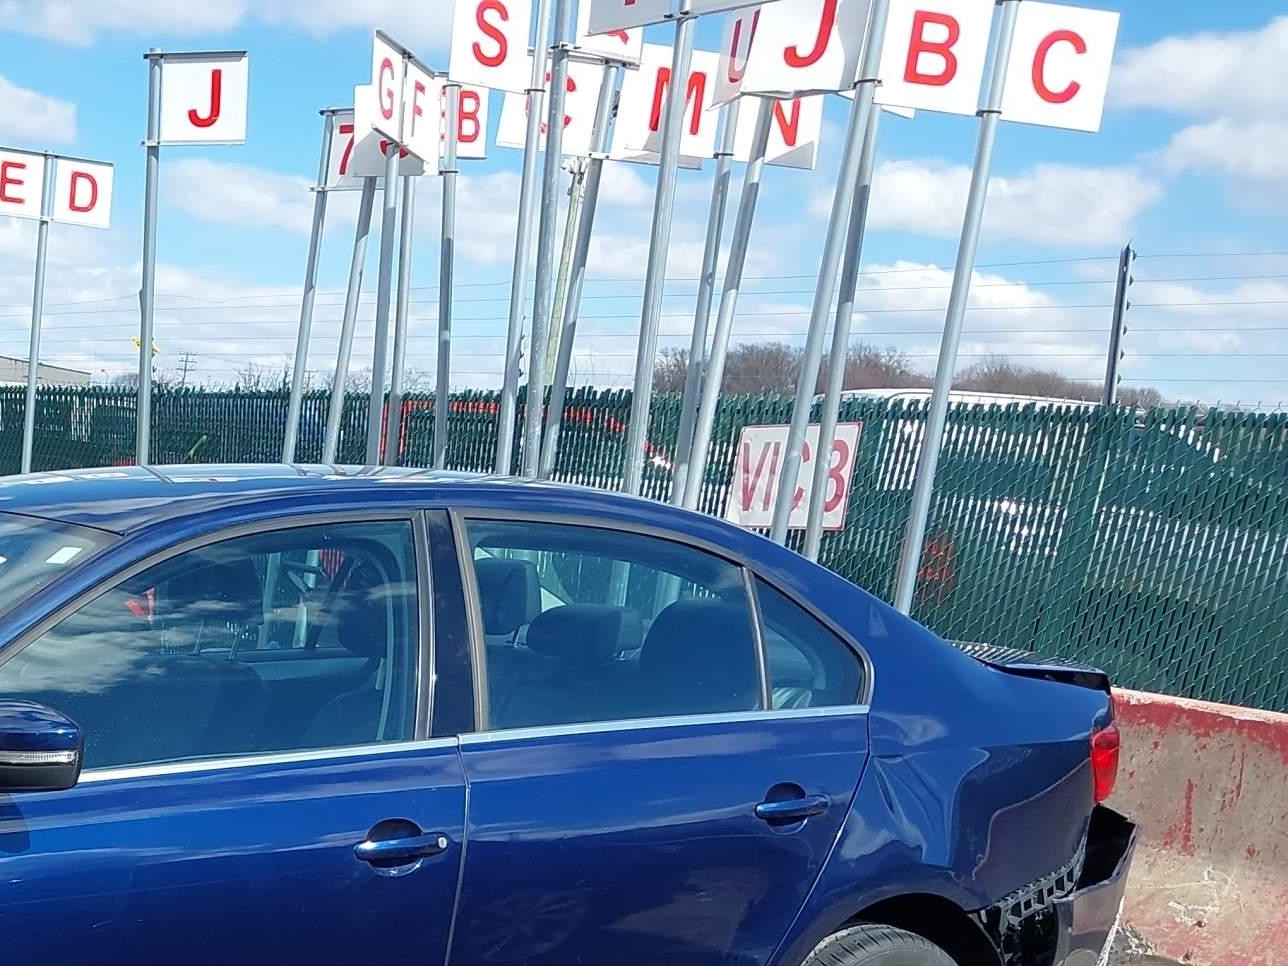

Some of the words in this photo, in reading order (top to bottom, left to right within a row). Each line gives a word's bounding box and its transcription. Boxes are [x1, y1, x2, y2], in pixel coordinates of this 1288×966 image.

[472, 0, 509, 67] S
[783, 0, 839, 68] J
[903, 9, 961, 87] B
[187, 68, 222, 128] J
[378, 57, 395, 121] G
[1031, 29, 1088, 104] C
[411, 79, 426, 137] F
[648, 66, 707, 136] M
[0, 160, 27, 204] E
[69, 170, 98, 212] D
